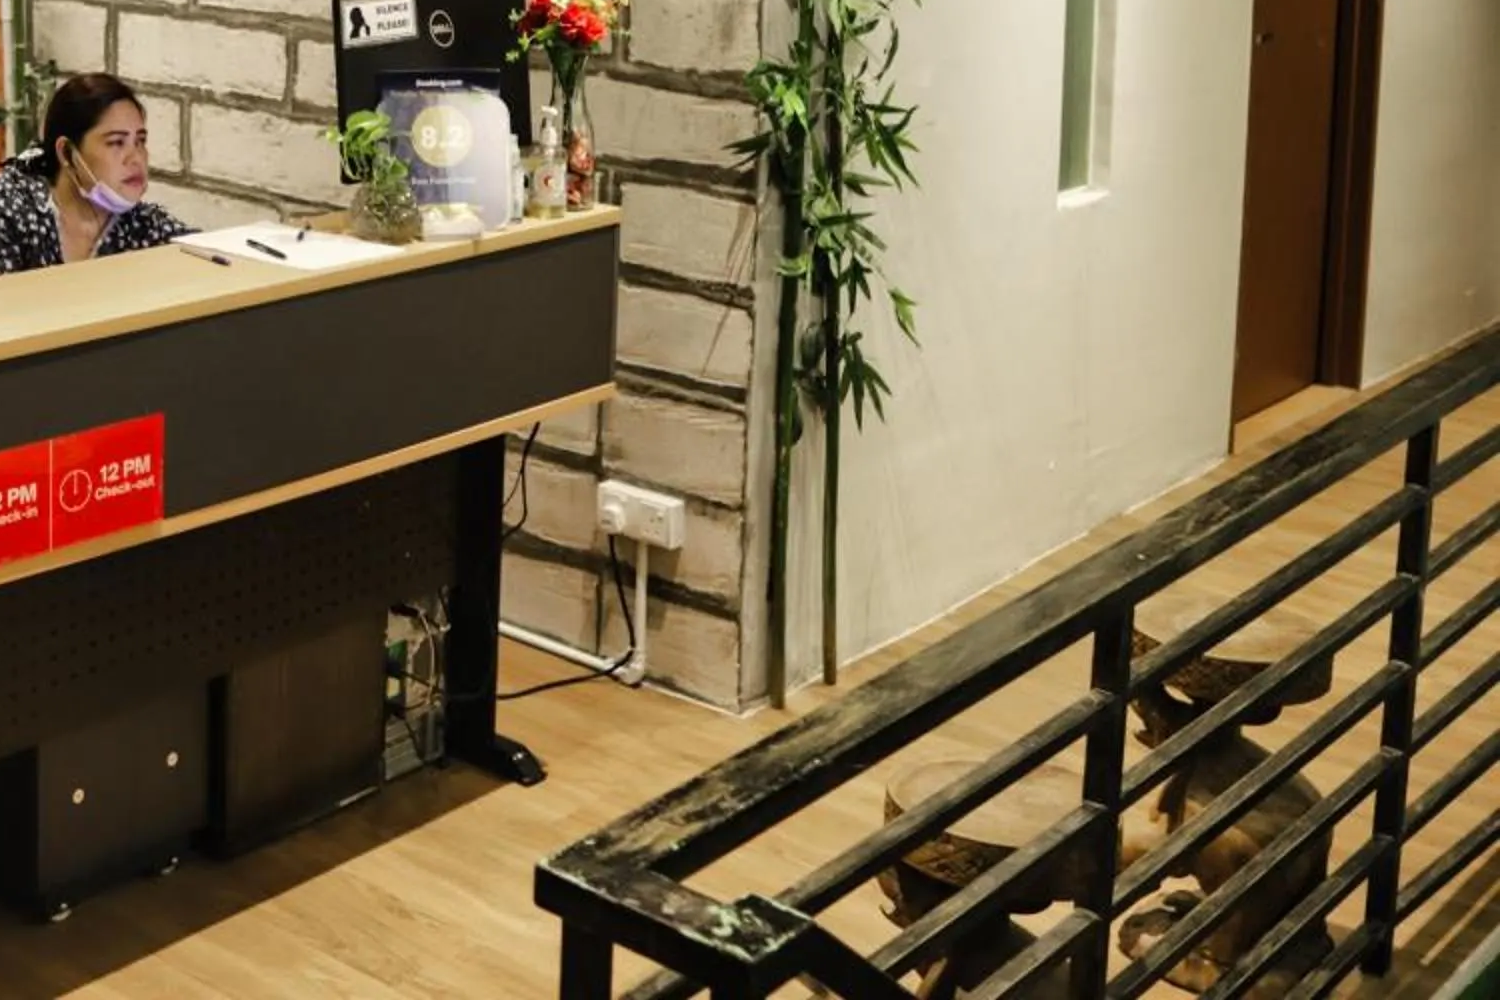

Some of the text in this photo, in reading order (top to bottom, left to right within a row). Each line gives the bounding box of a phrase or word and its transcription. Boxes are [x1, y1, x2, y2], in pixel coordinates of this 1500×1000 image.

[375, 1, 409, 15] SILENCE
[420, 125, 465, 151] 8.2
[99, 453, 152, 484] 12 PM
[7, 482, 37, 508] PM
[94, 474, 156, 501] Check-out
